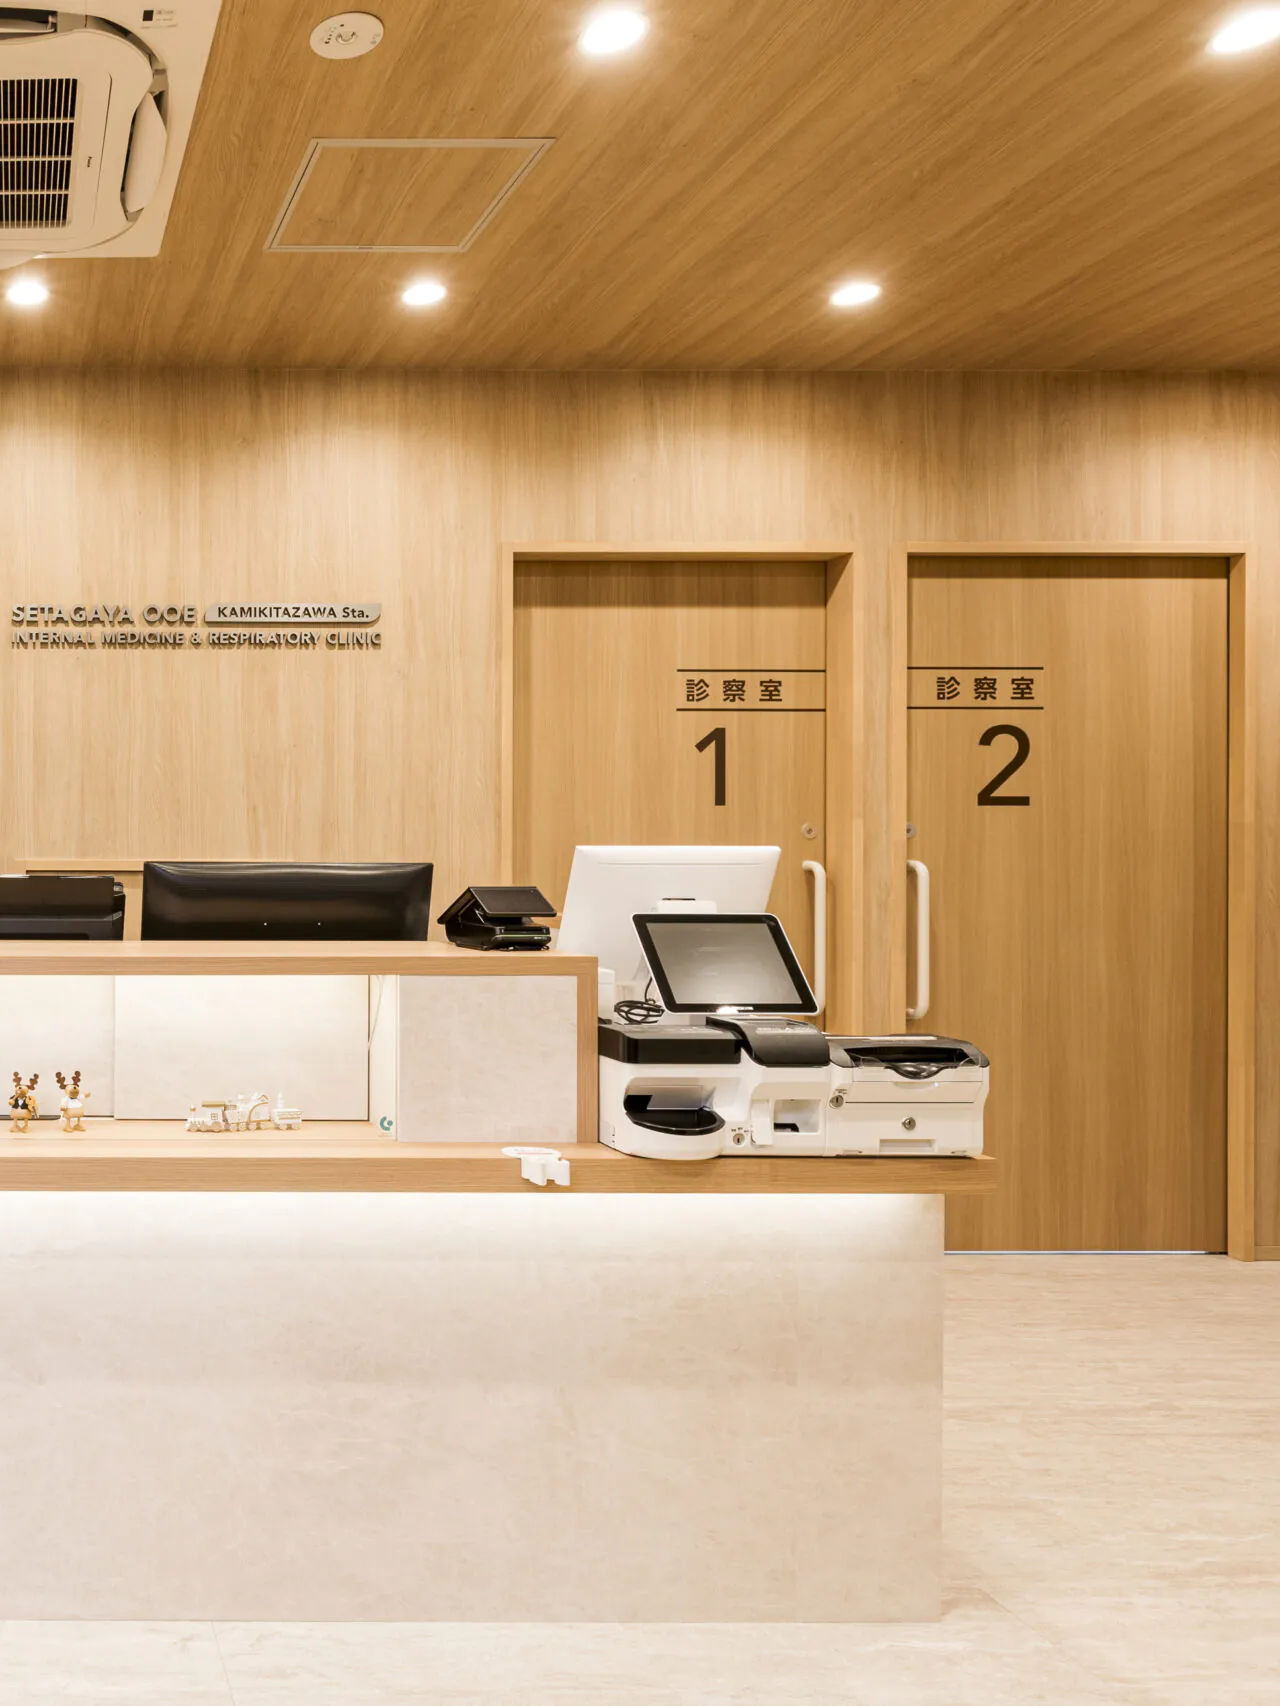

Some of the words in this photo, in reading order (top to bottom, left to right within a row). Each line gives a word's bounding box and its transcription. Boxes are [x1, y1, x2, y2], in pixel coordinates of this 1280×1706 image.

[11, 604, 135, 623] SETAGAYA
[143, 604, 197, 623] OOE
[217, 606, 337, 618] KAMIKITAZAWA
[342, 606, 370, 618] Sta.
[11, 631, 96, 645] INTERNAL
[101, 631, 185, 645] MEDICINE
[190, 631, 202, 645] &
[208, 631, 320, 645] RESPIRATORY
[325, 631, 382, 645] CLINIC
[685, 678, 783, 703] 診察室
[935, 676, 1036, 701] 診察室
[694, 727, 726, 807] 1
[976, 724, 1031, 807] 2
